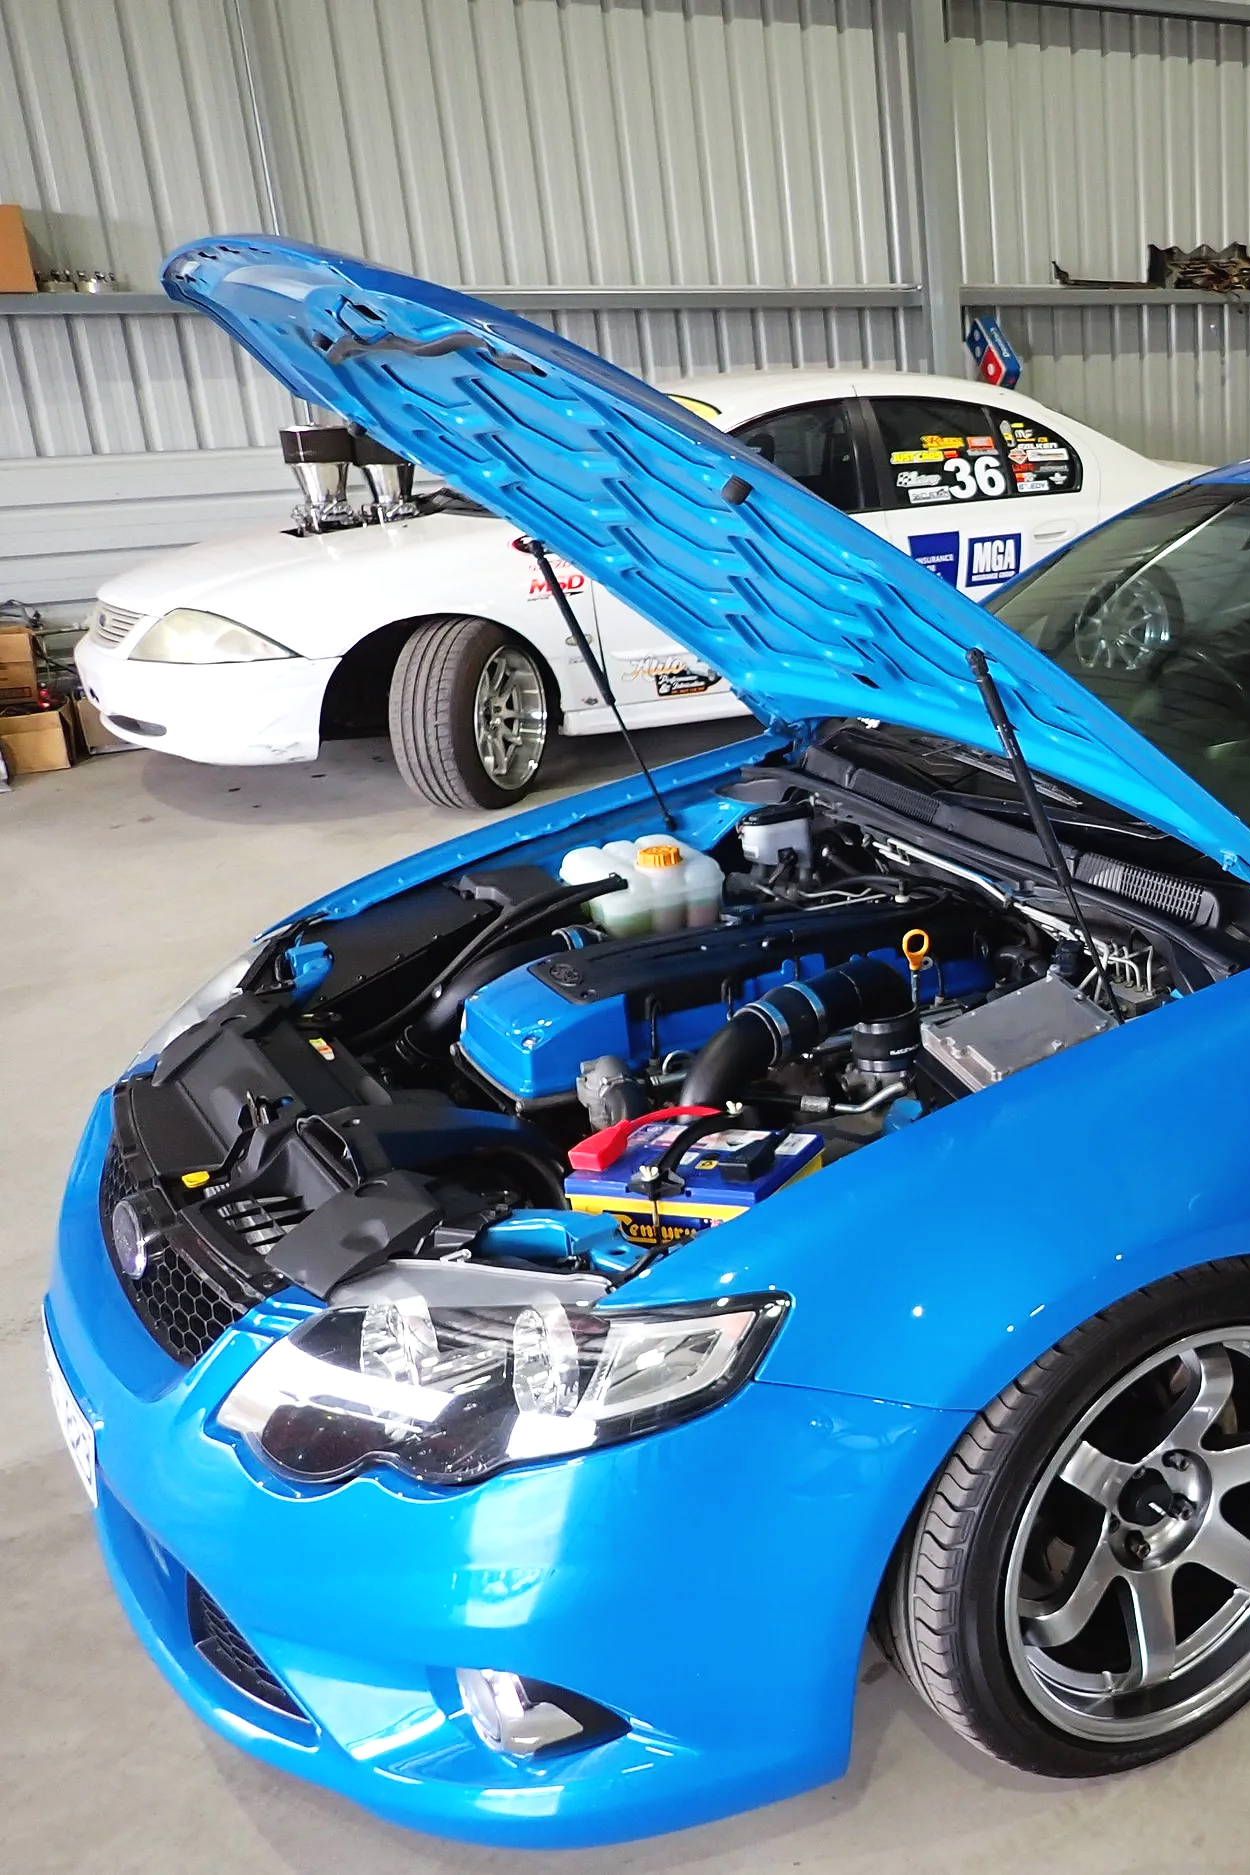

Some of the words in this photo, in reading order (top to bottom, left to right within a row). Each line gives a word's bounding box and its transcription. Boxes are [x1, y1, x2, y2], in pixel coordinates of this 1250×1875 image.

[943, 455, 1006, 499] 36
[972, 539, 1016, 574] MGA
[613, 1213, 697, 1241] Cenur
